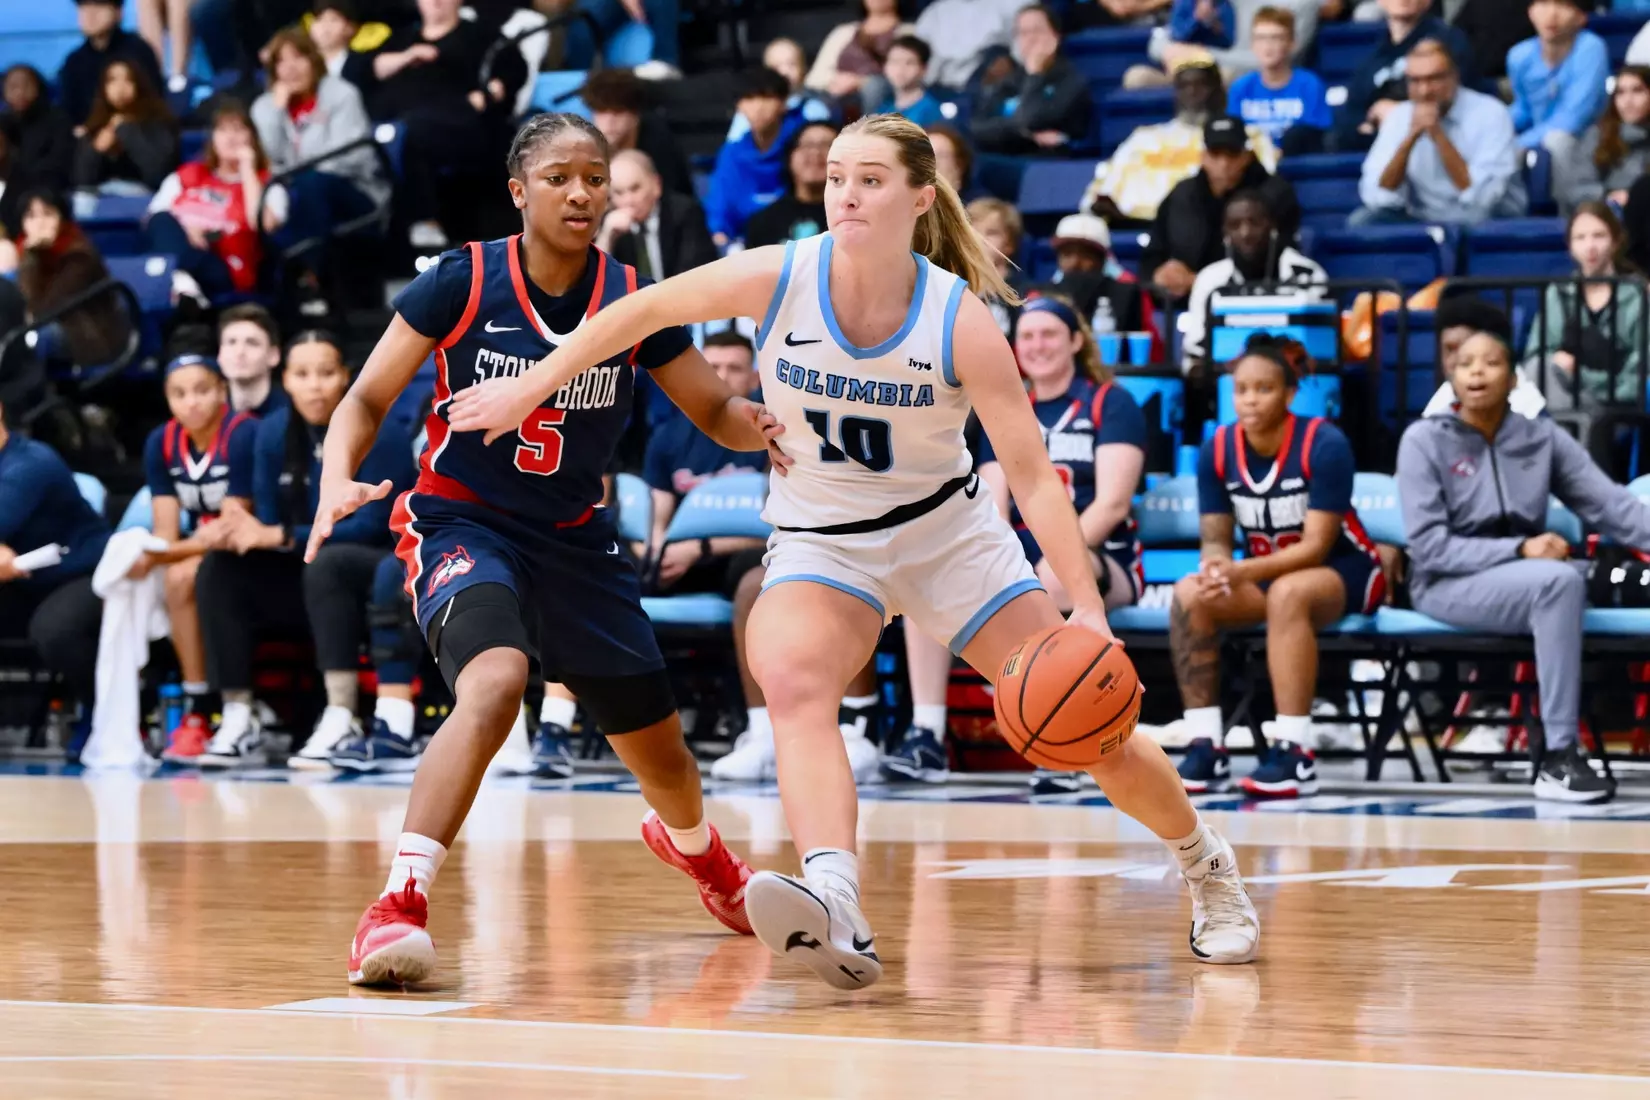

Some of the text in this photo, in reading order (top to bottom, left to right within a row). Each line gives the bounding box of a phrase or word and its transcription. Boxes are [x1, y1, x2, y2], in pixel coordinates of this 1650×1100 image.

[555, 365, 621, 410] BROOK
[776, 358, 934, 407] COLUMBIA
[908, 358, 925, 371] Ivy
[513, 407, 567, 476] 5
[802, 407, 894, 473] 10
